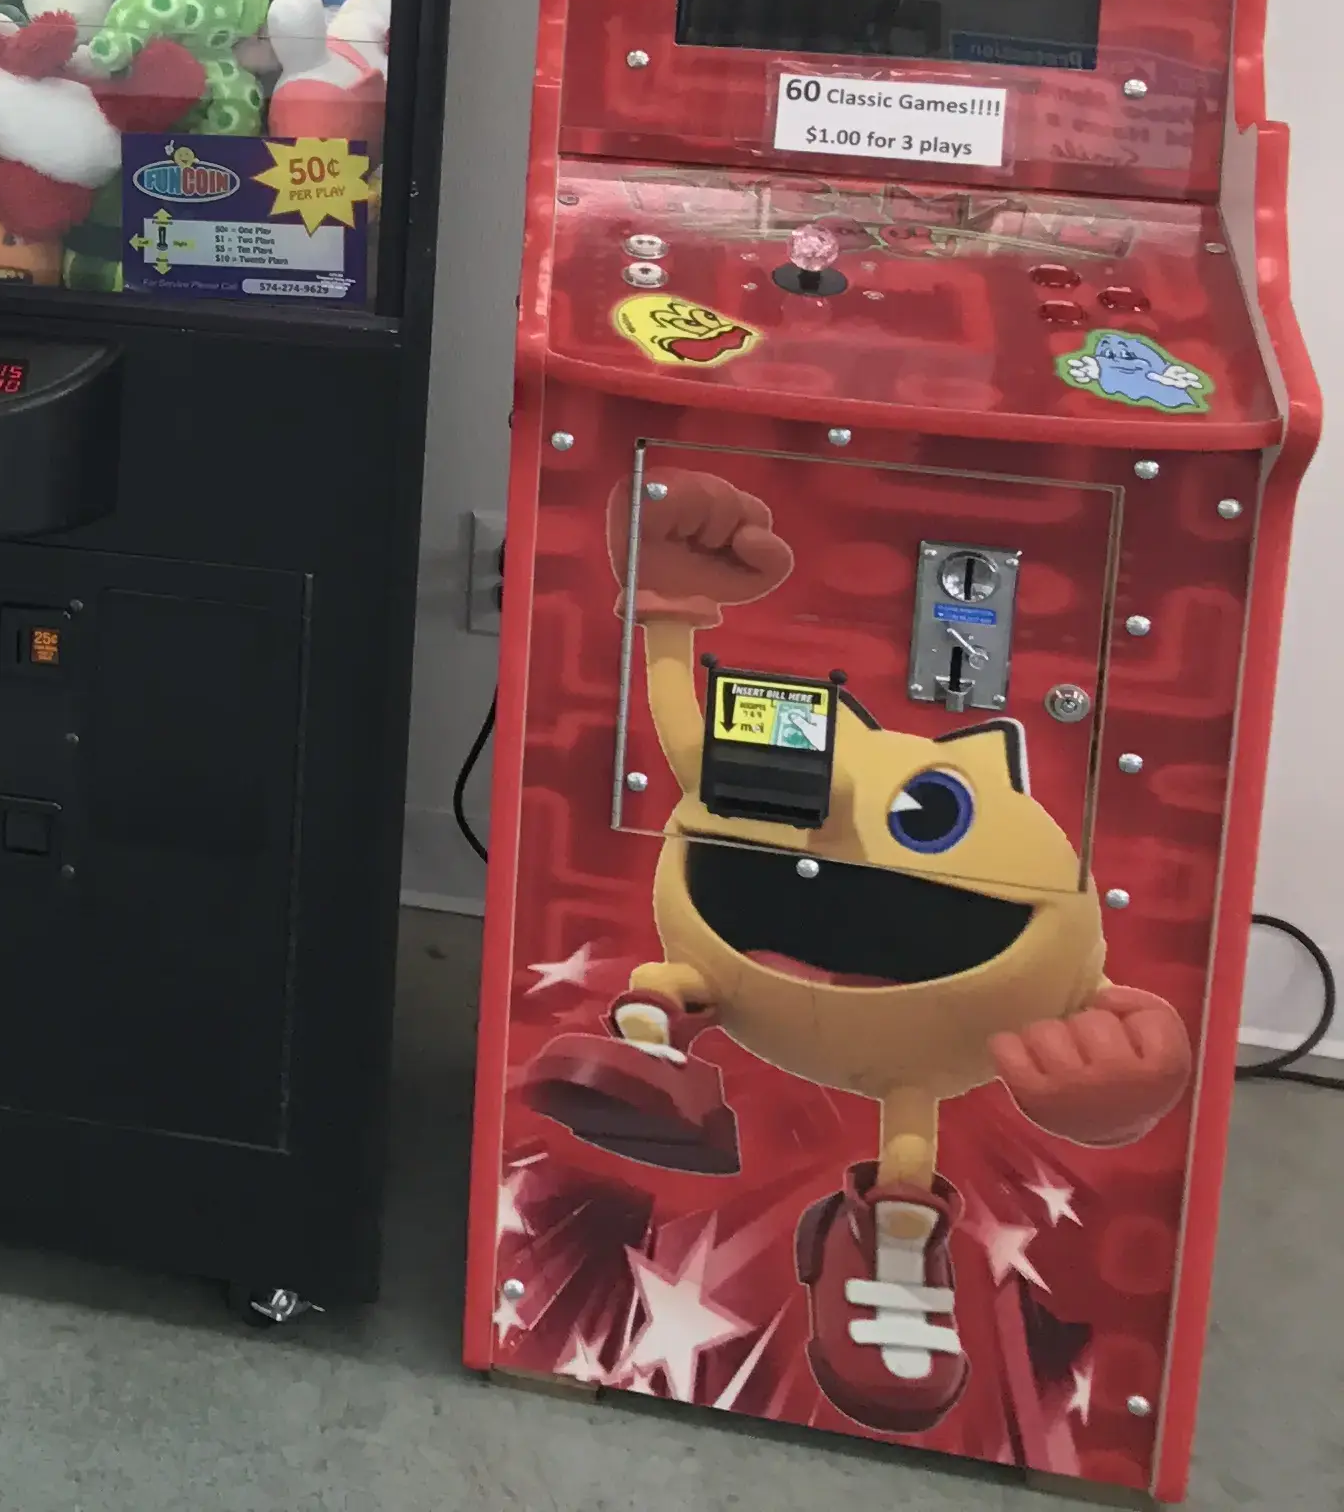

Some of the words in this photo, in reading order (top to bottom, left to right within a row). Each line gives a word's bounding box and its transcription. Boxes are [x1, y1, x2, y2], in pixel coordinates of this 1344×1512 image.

[785, 78, 821, 103] 60
[826, 88, 893, 111] Classic
[898, 94, 1001, 118] Games!!!!
[805, 126, 861, 149] $1.00
[866, 129, 896, 149] for
[900, 134, 913, 151] 3
[918, 136, 973, 158] plays
[289, 155, 340, 186] 50¢
[289, 188, 313, 201] PER
[315, 186, 347, 200] PLAY
[0, 364, 22, 379] 15
[34, 631, 58, 644] 25¢
[732, 683, 765, 697] INSERT
[766, 688, 785, 701] BILL
[788, 691, 814, 703] HERE
